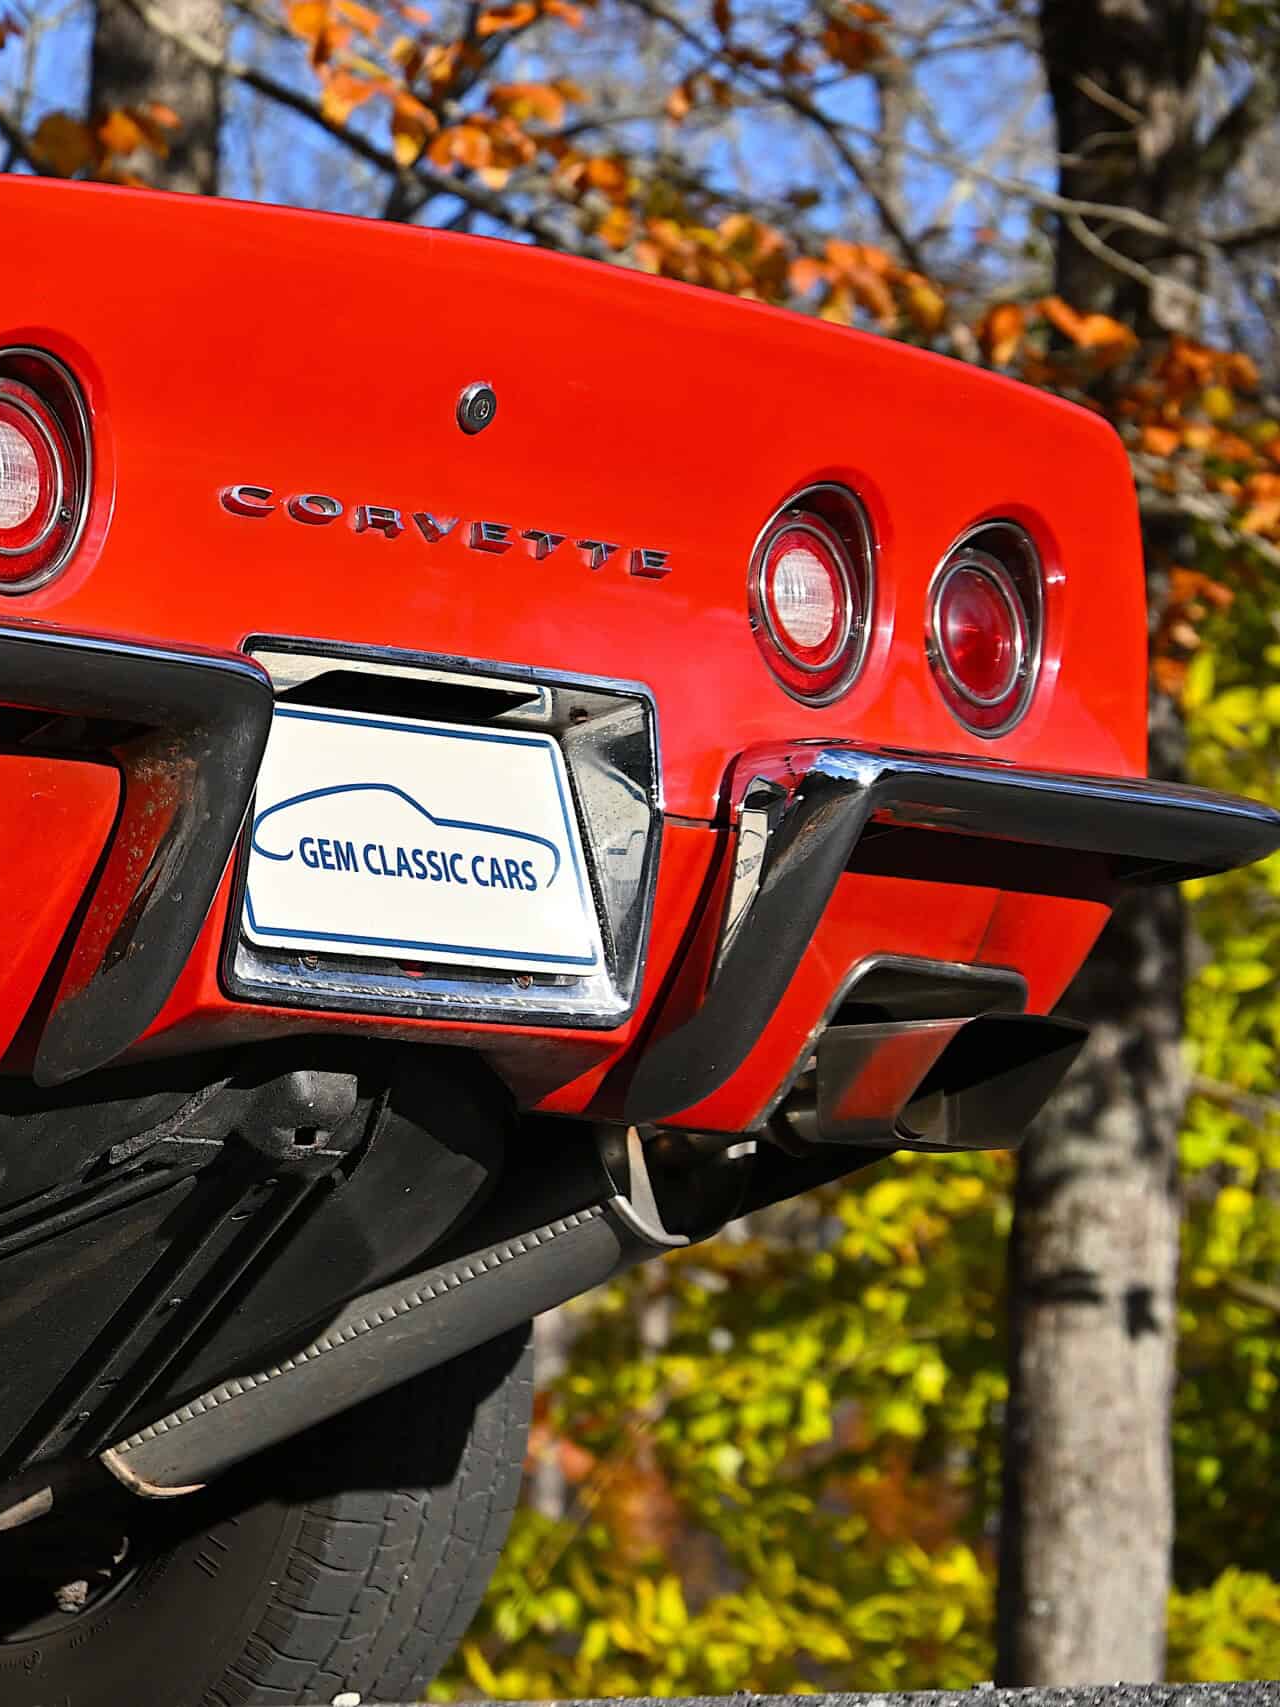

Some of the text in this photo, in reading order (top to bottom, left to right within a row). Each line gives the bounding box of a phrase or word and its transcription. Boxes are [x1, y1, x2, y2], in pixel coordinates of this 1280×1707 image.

[219, 484, 673, 580] CORVETTE
[298, 836, 538, 892] GEM CLASSIC CARS
